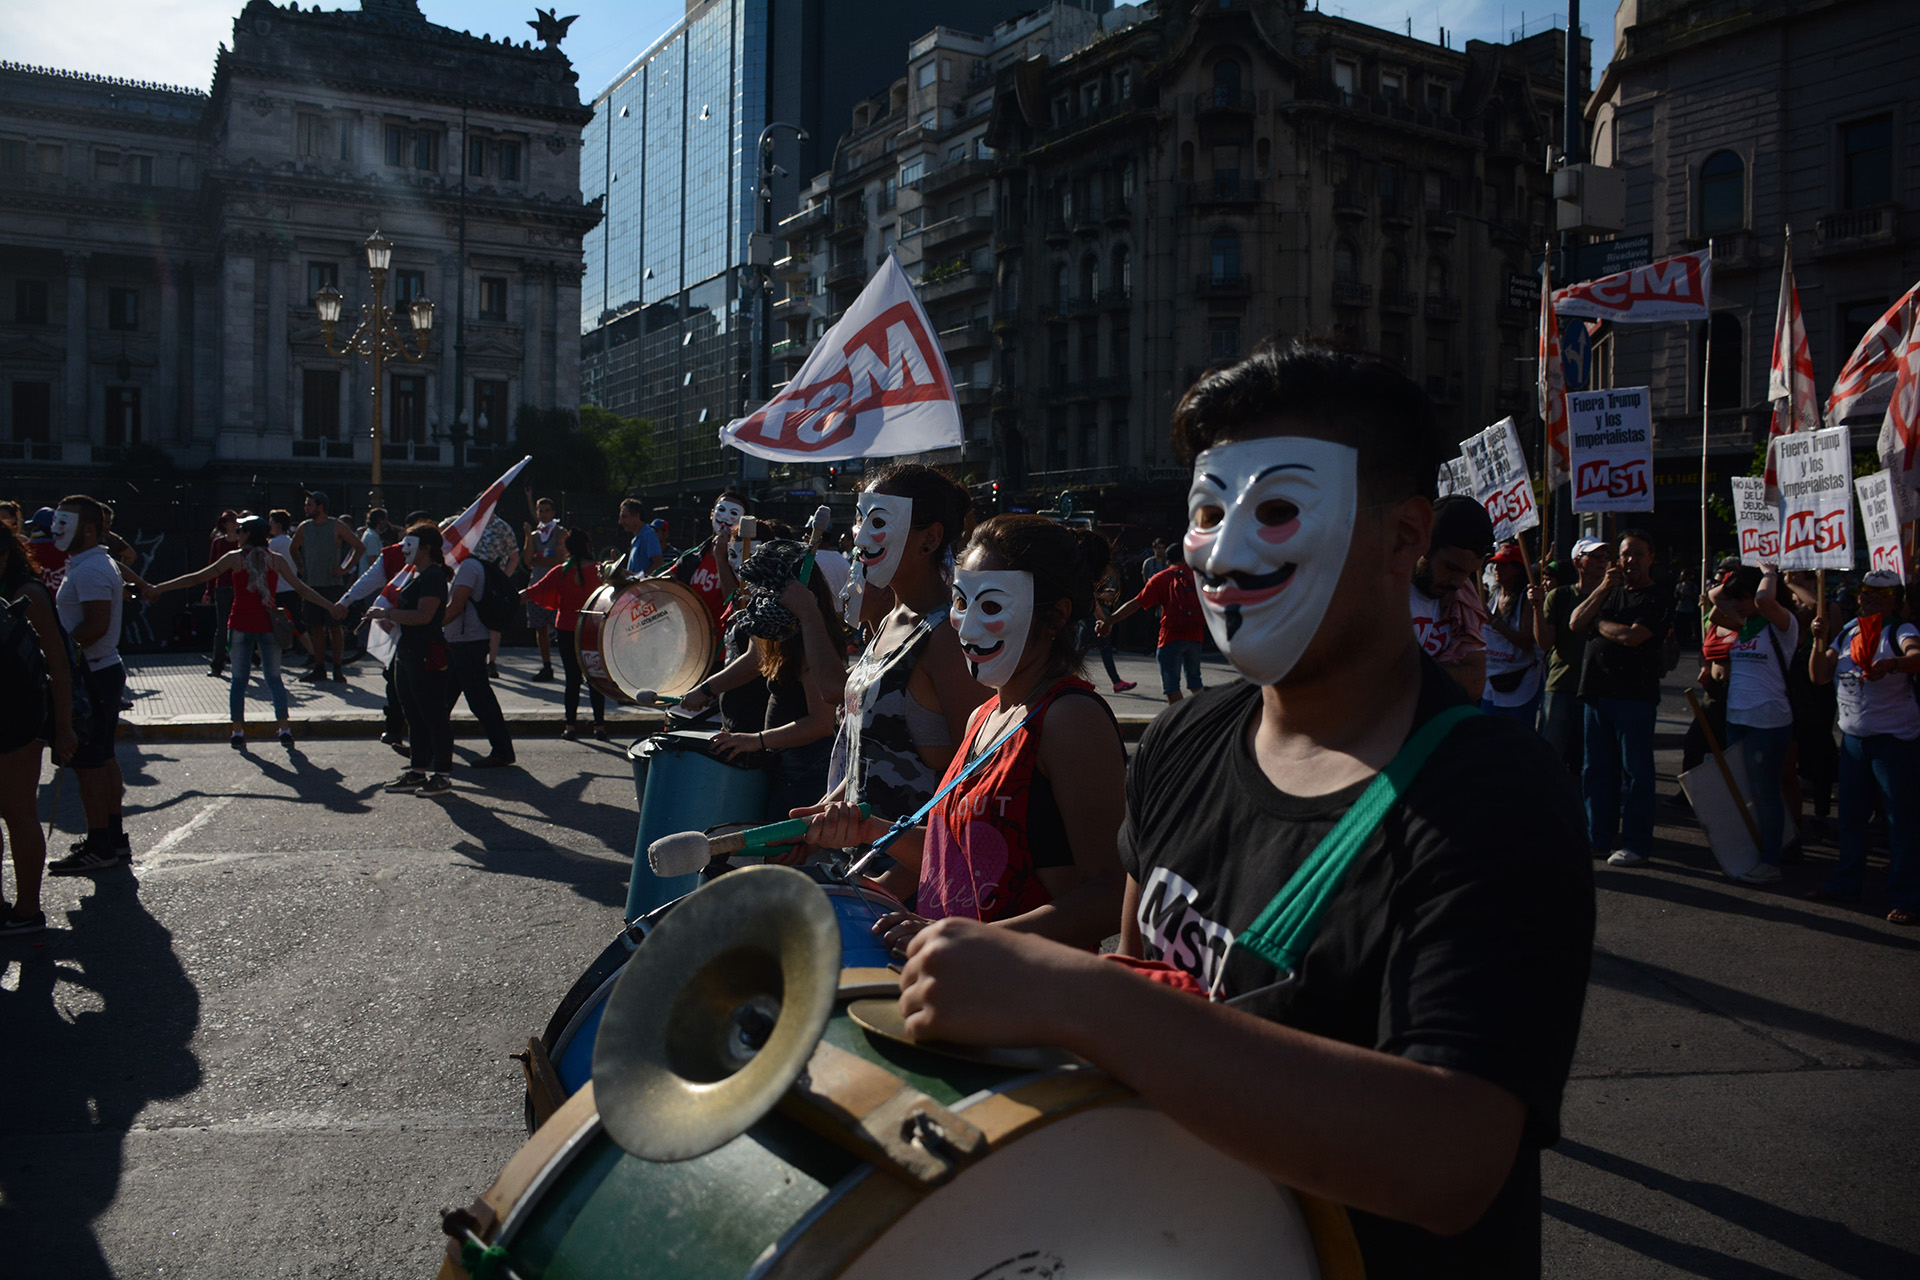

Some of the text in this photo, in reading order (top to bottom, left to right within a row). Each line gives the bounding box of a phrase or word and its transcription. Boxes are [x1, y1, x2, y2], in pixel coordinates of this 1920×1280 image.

[1614, 237, 1648, 250] Avenida
[1606, 248, 1649, 263] Rivadavia
[1602, 262, 1621, 274] 1800
[1511, 275, 1537, 289] Avenida
[1573, 393, 1641, 413] Fuera Trump
[1595, 412, 1622, 430] y los
[1575, 428, 1646, 449] imperialistas
[1781, 433, 1840, 459] Fuera Trump
[1466, 443, 1477, 458] No
[1801, 457, 1824, 478] y los
[1579, 461, 1647, 497] MST
[1733, 481, 1743, 489] NO
[1744, 481, 1754, 490] AL
[1783, 474, 1845, 499] imperialistas
[1485, 484, 1531, 524] MST
[1744, 491, 1754, 500] DE
[1740, 511, 1775, 521] EXTERNA
[1743, 501, 1769, 511] DEUDA
[1787, 512, 1846, 552] MST
[1744, 530, 1778, 556] MST
[631, 599, 656, 621] MST
[1139, 871, 1232, 992] MST
